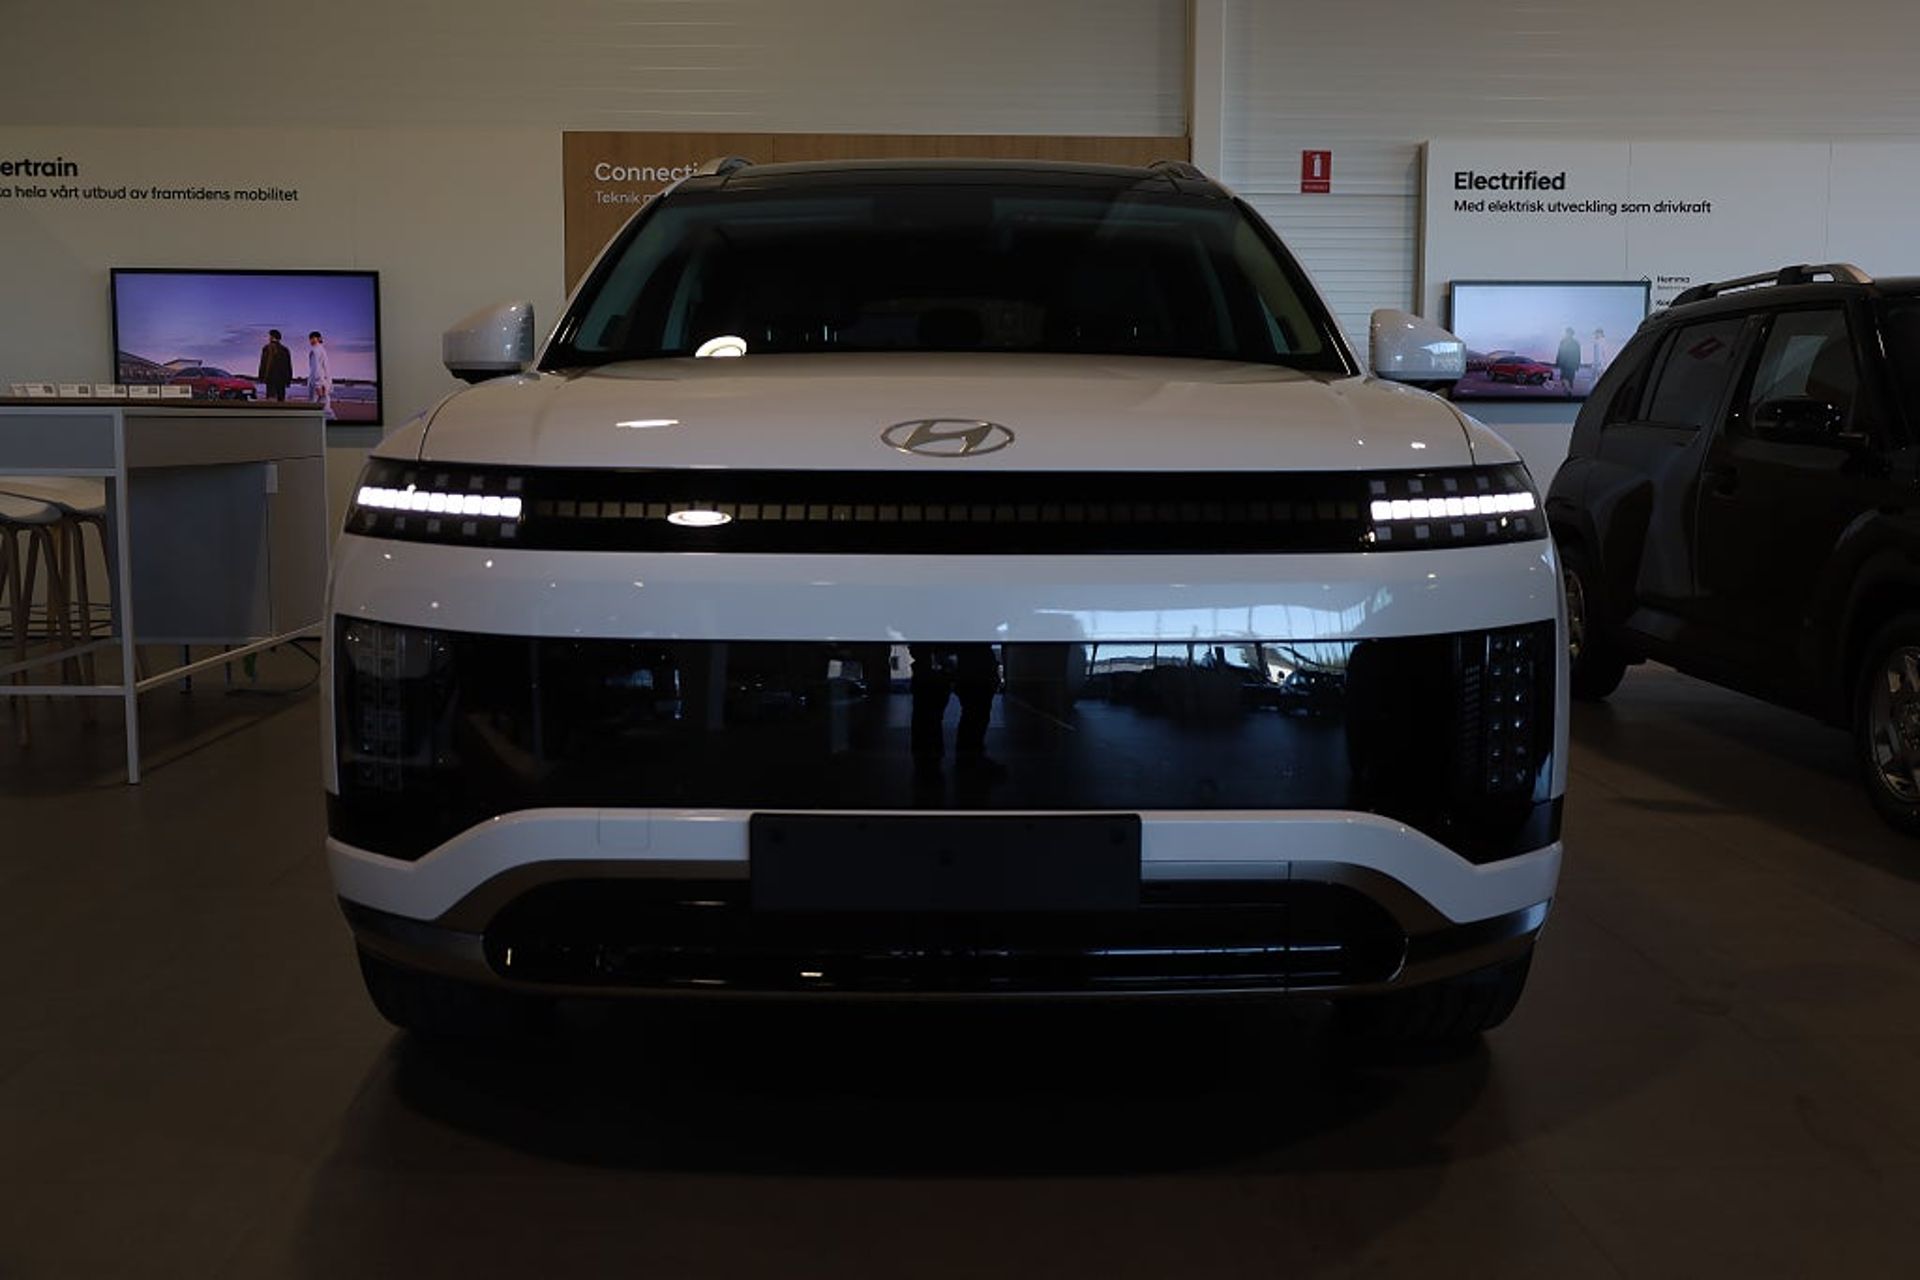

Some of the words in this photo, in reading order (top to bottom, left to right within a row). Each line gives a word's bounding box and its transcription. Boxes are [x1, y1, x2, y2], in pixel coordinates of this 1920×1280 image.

[1454, 170, 1566, 190] Electrified
[15, 185, 47, 198] hela
[50, 184, 79, 199] vårt
[83, 185, 127, 199] utbud
[130, 188, 148, 200] av
[151, 186, 231, 200] framtidens
[233, 187, 299, 201] mobilitet
[594, 190, 642, 204] Teknik
[1454, 199, 1485, 213] Med
[1488, 199, 1545, 213] elektrisk
[1547, 199, 1617, 216] utveckling
[1620, 202, 1651, 213] som
[1653, 199, 1712, 213] drivkraft
